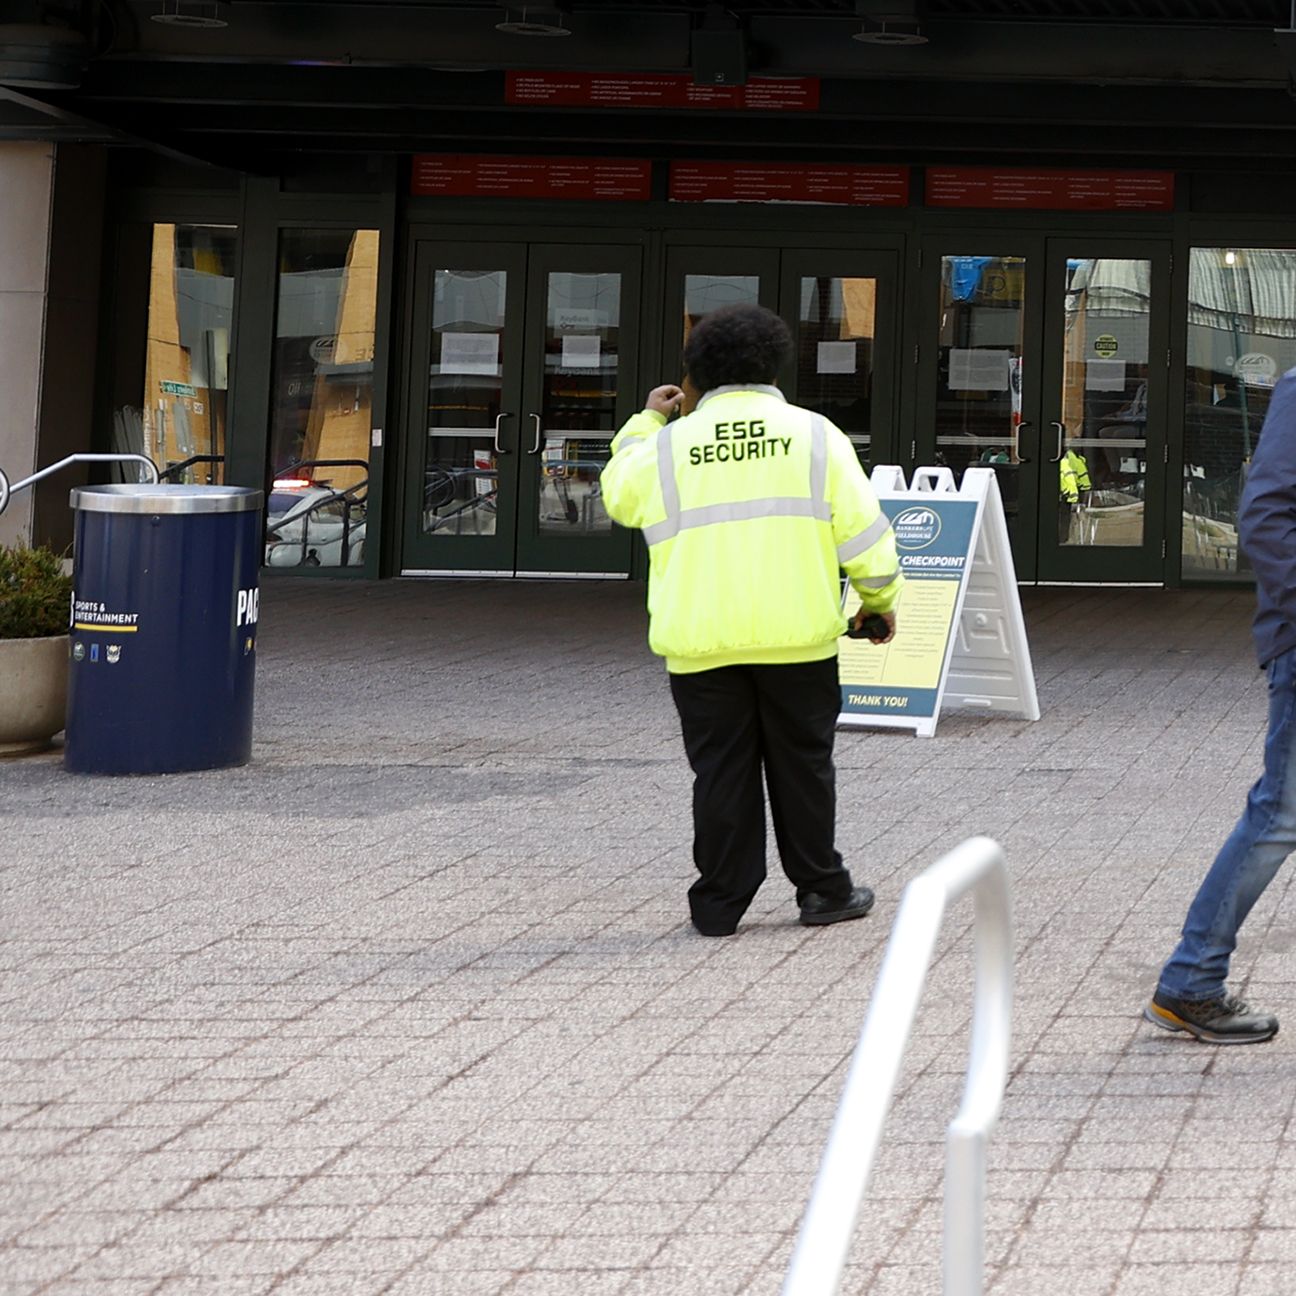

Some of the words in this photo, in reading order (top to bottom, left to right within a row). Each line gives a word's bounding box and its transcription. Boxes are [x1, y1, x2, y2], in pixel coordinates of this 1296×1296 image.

[715, 420, 765, 441] ESG
[690, 438, 791, 465] SECURITY
[902, 555, 965, 567] CHECKPOINT
[75, 601, 98, 612] SPORTS
[75, 611, 139, 623] ENTERTAINMENT
[848, 695, 881, 706] THANK
[883, 696, 908, 708] YOU!
